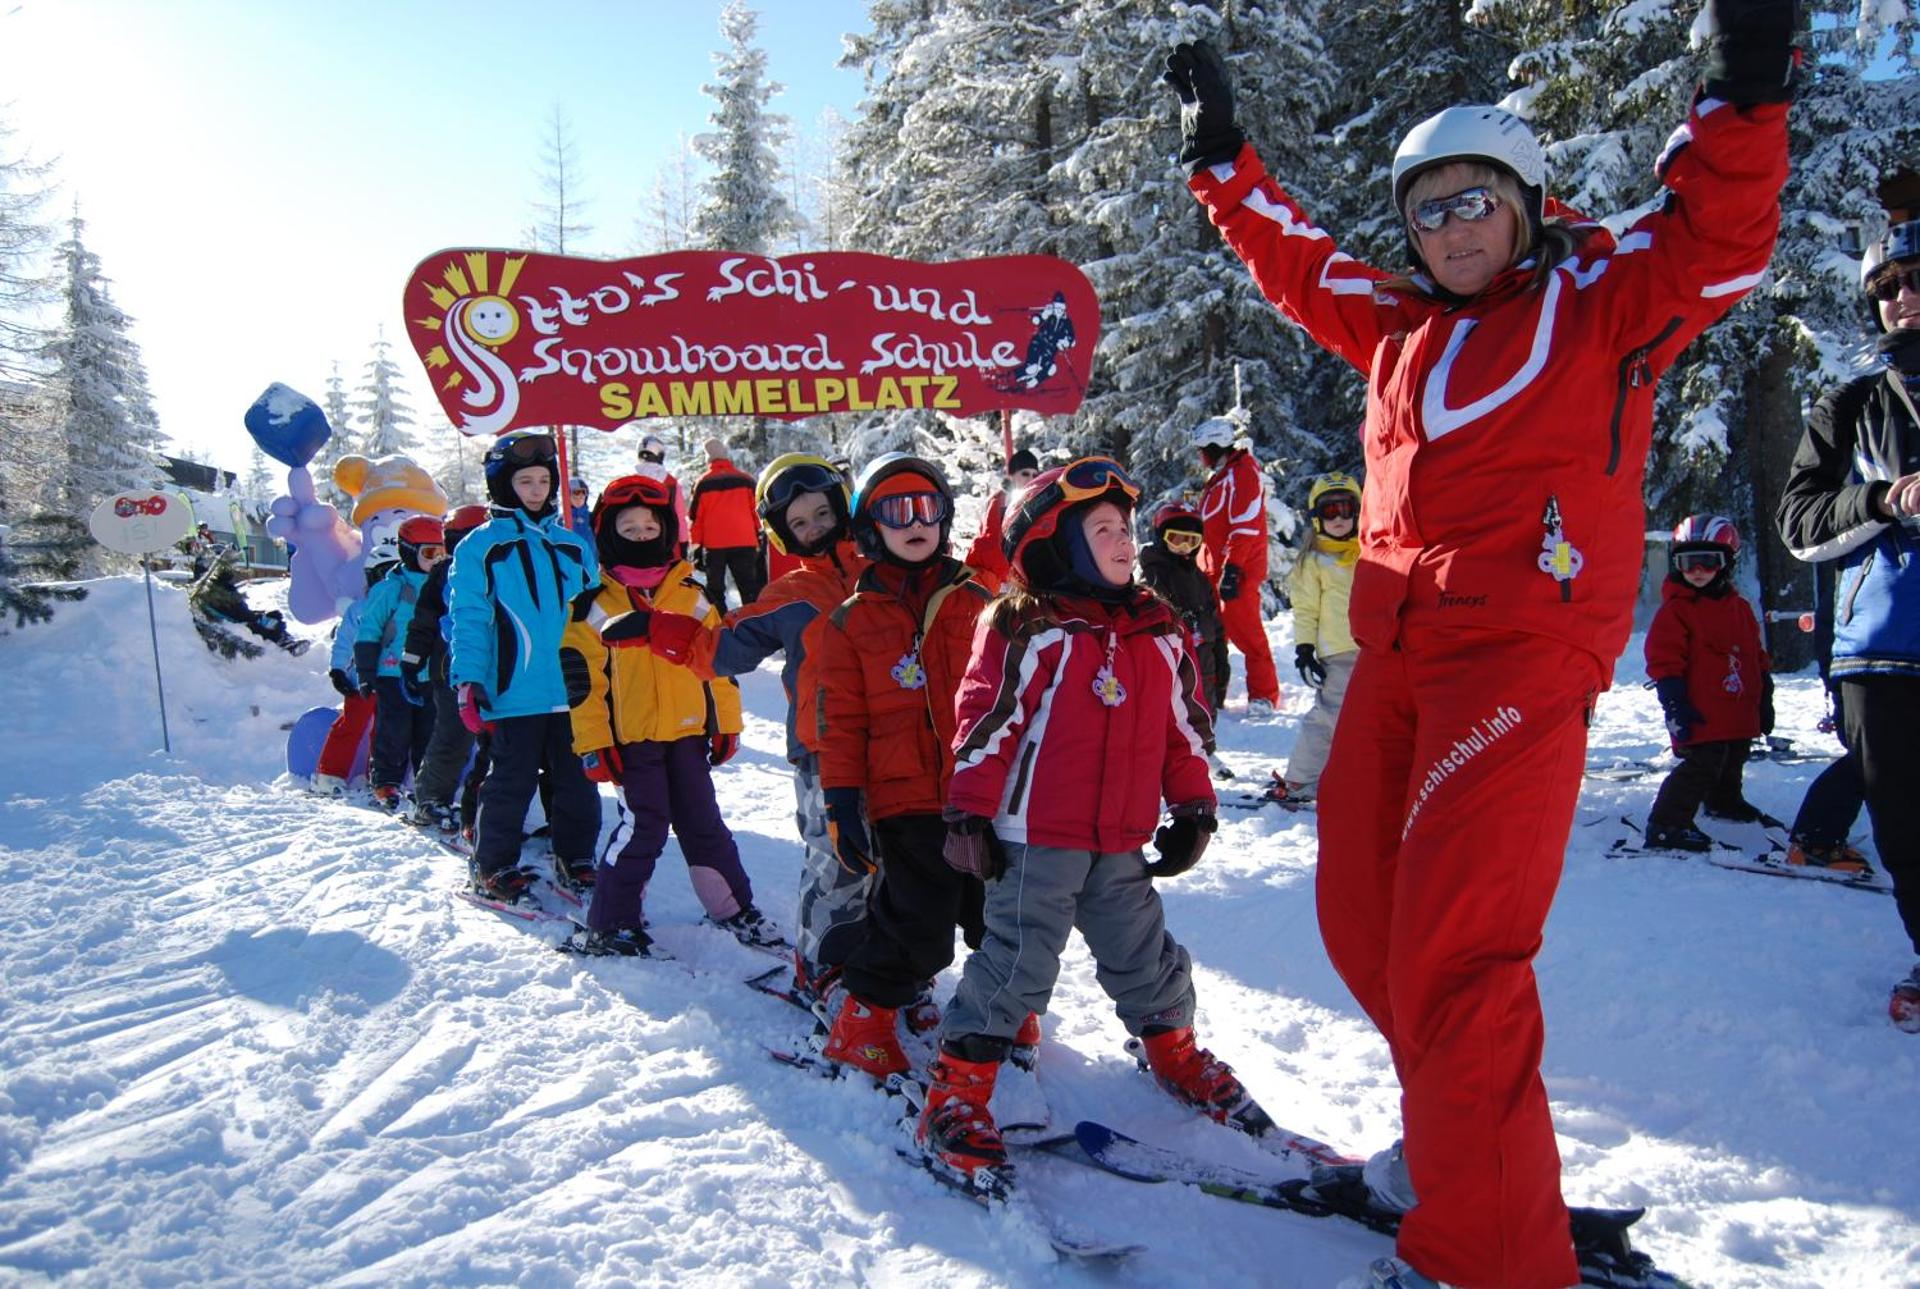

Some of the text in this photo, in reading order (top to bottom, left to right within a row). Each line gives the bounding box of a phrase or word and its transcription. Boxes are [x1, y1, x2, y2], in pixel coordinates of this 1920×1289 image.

[867, 284, 993, 325] und
[518, 331, 1022, 384] Snowboard Schule
[600, 375, 962, 420] SAMMELPLATZ
